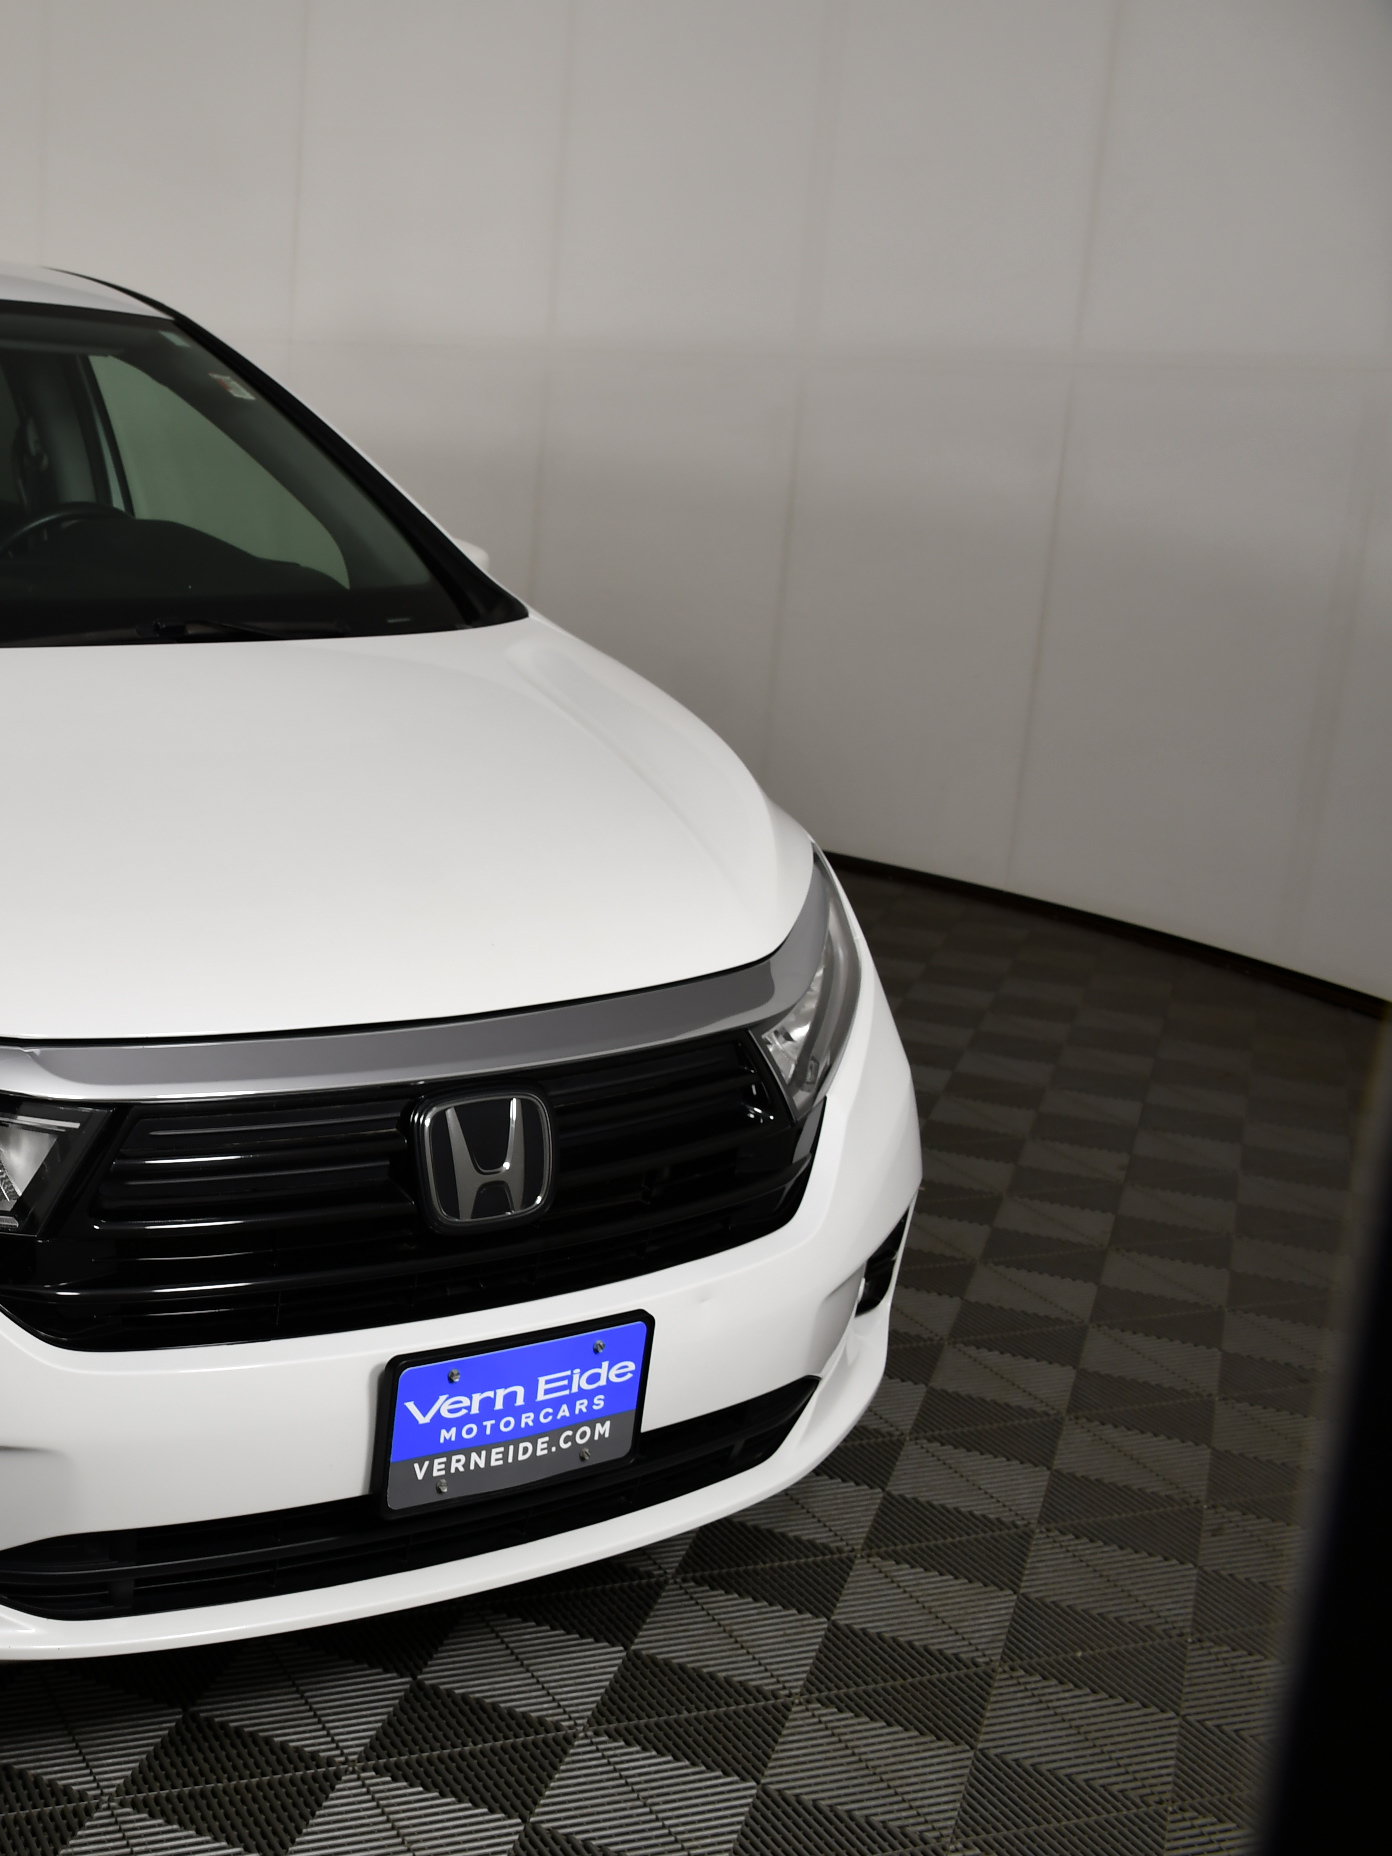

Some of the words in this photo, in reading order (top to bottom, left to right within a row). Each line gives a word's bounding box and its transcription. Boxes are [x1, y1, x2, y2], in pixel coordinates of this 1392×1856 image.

[404, 1383, 526, 1425] Vern
[536, 1360, 636, 1402] Eide
[439, 1394, 606, 1444] MOTORCARS
[413, 1420, 611, 1481] VERNEIDE.COM
